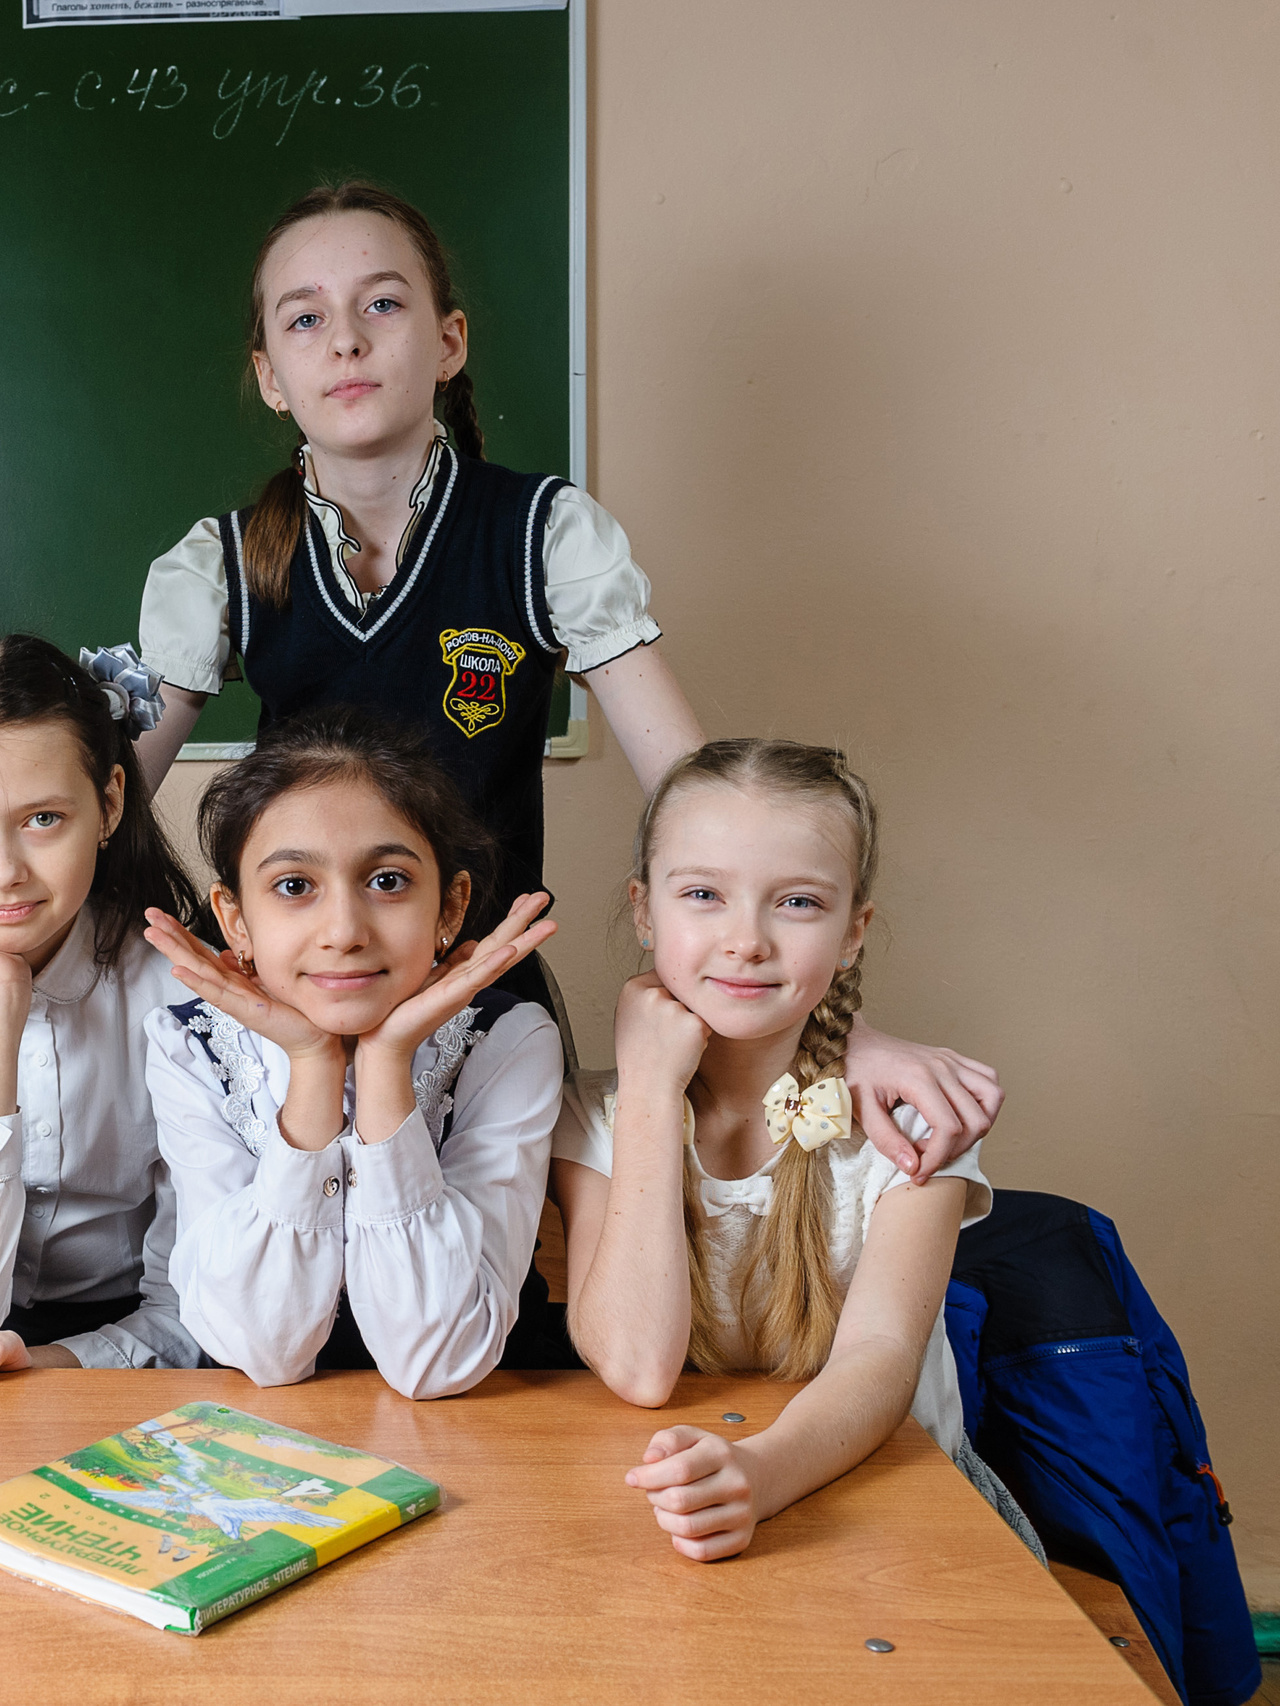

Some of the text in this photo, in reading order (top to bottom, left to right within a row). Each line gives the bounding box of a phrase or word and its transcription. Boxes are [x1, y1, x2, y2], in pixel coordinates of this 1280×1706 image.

[51, 3, 87, 12] Глаголы
[133, 0, 174, 10] бежать
[445, 632, 517, 661] РОСТОВ-НА-ДОНУ
[460, 653, 501, 673] ШКОЛА
[456, 671, 496, 700] 22
[280, 1477, 334, 1497] 4
[9, 1502, 142, 1561] ЧТЕНИЕ
[200, 1557, 309, 1623] ЛИТЕРАТУРНОЕ ЧТЕНИЕ
